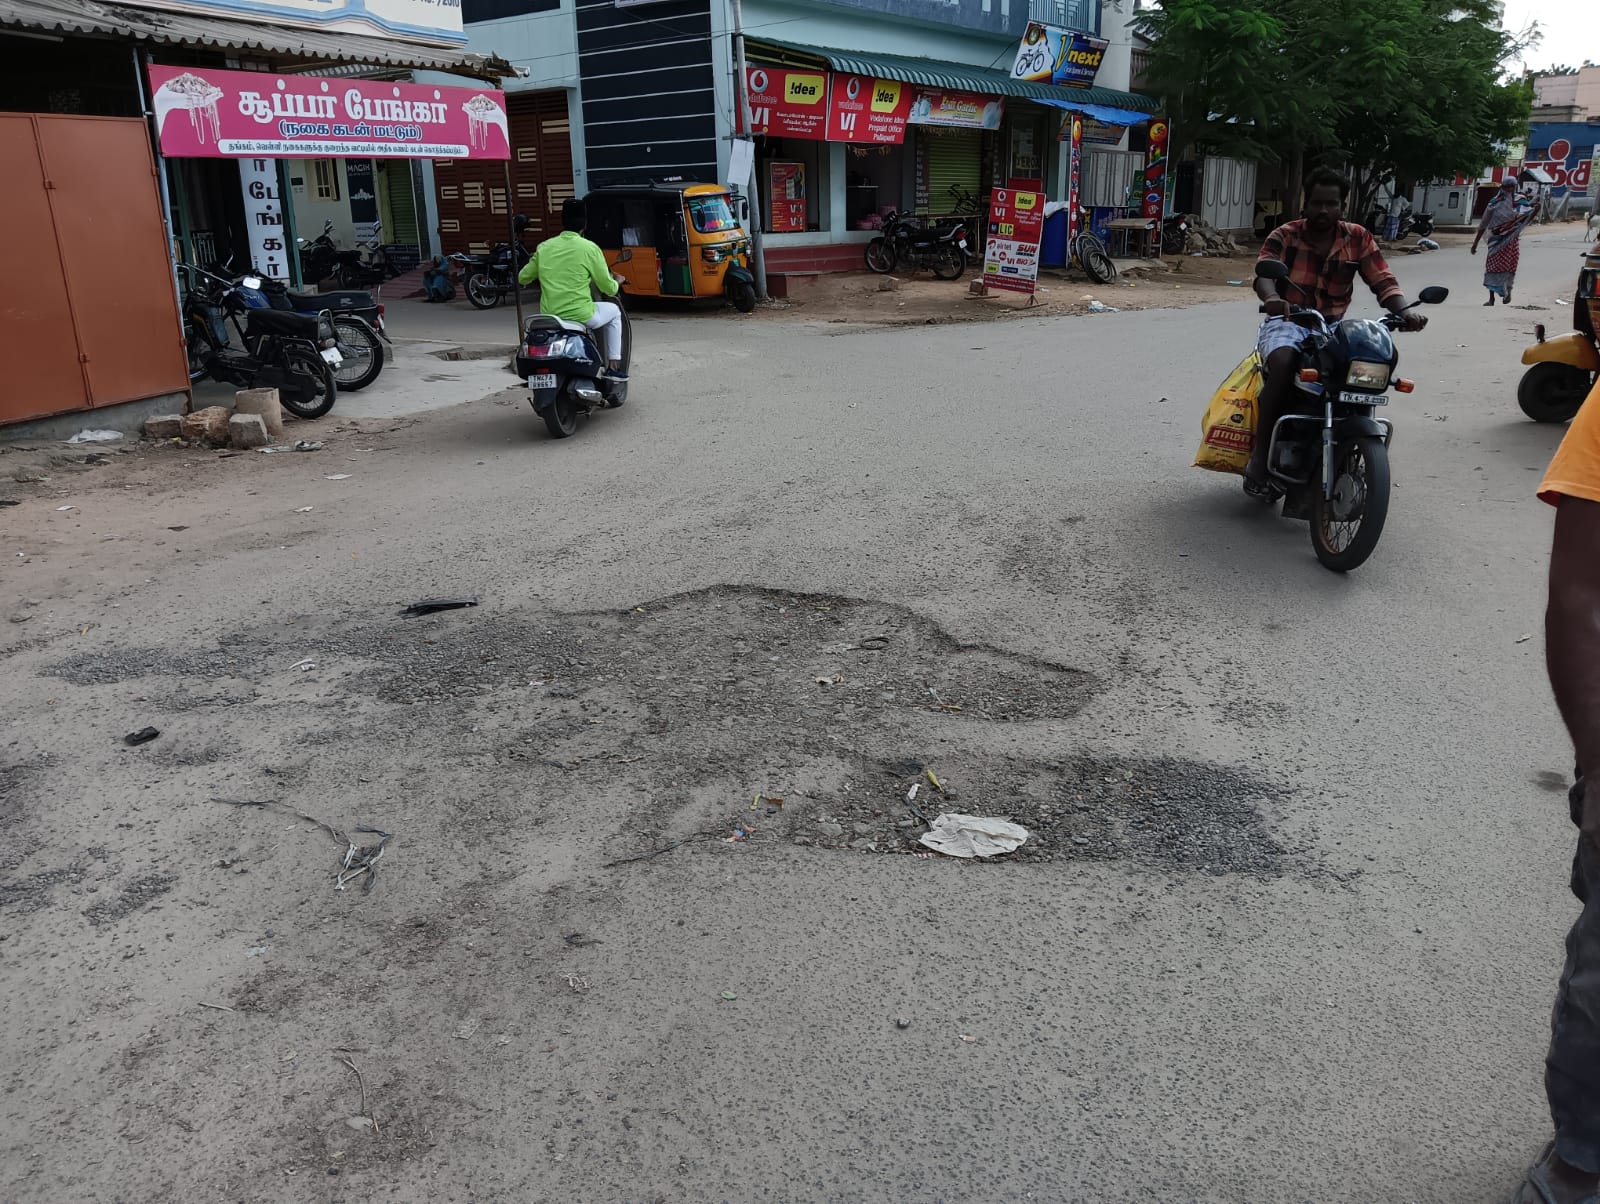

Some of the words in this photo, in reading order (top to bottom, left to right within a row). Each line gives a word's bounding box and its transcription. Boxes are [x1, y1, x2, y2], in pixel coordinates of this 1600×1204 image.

[238, 79, 337, 124] சூப்பர்
[344, 87, 448, 124] பேங்கர்
[279, 120, 329, 138] (நகை
[333, 122, 371, 137] கடன்
[374, 124, 422, 140] மட்டும்)
[1000, 224, 1012, 234] LIC
[1017, 244, 1038, 253] SUN
